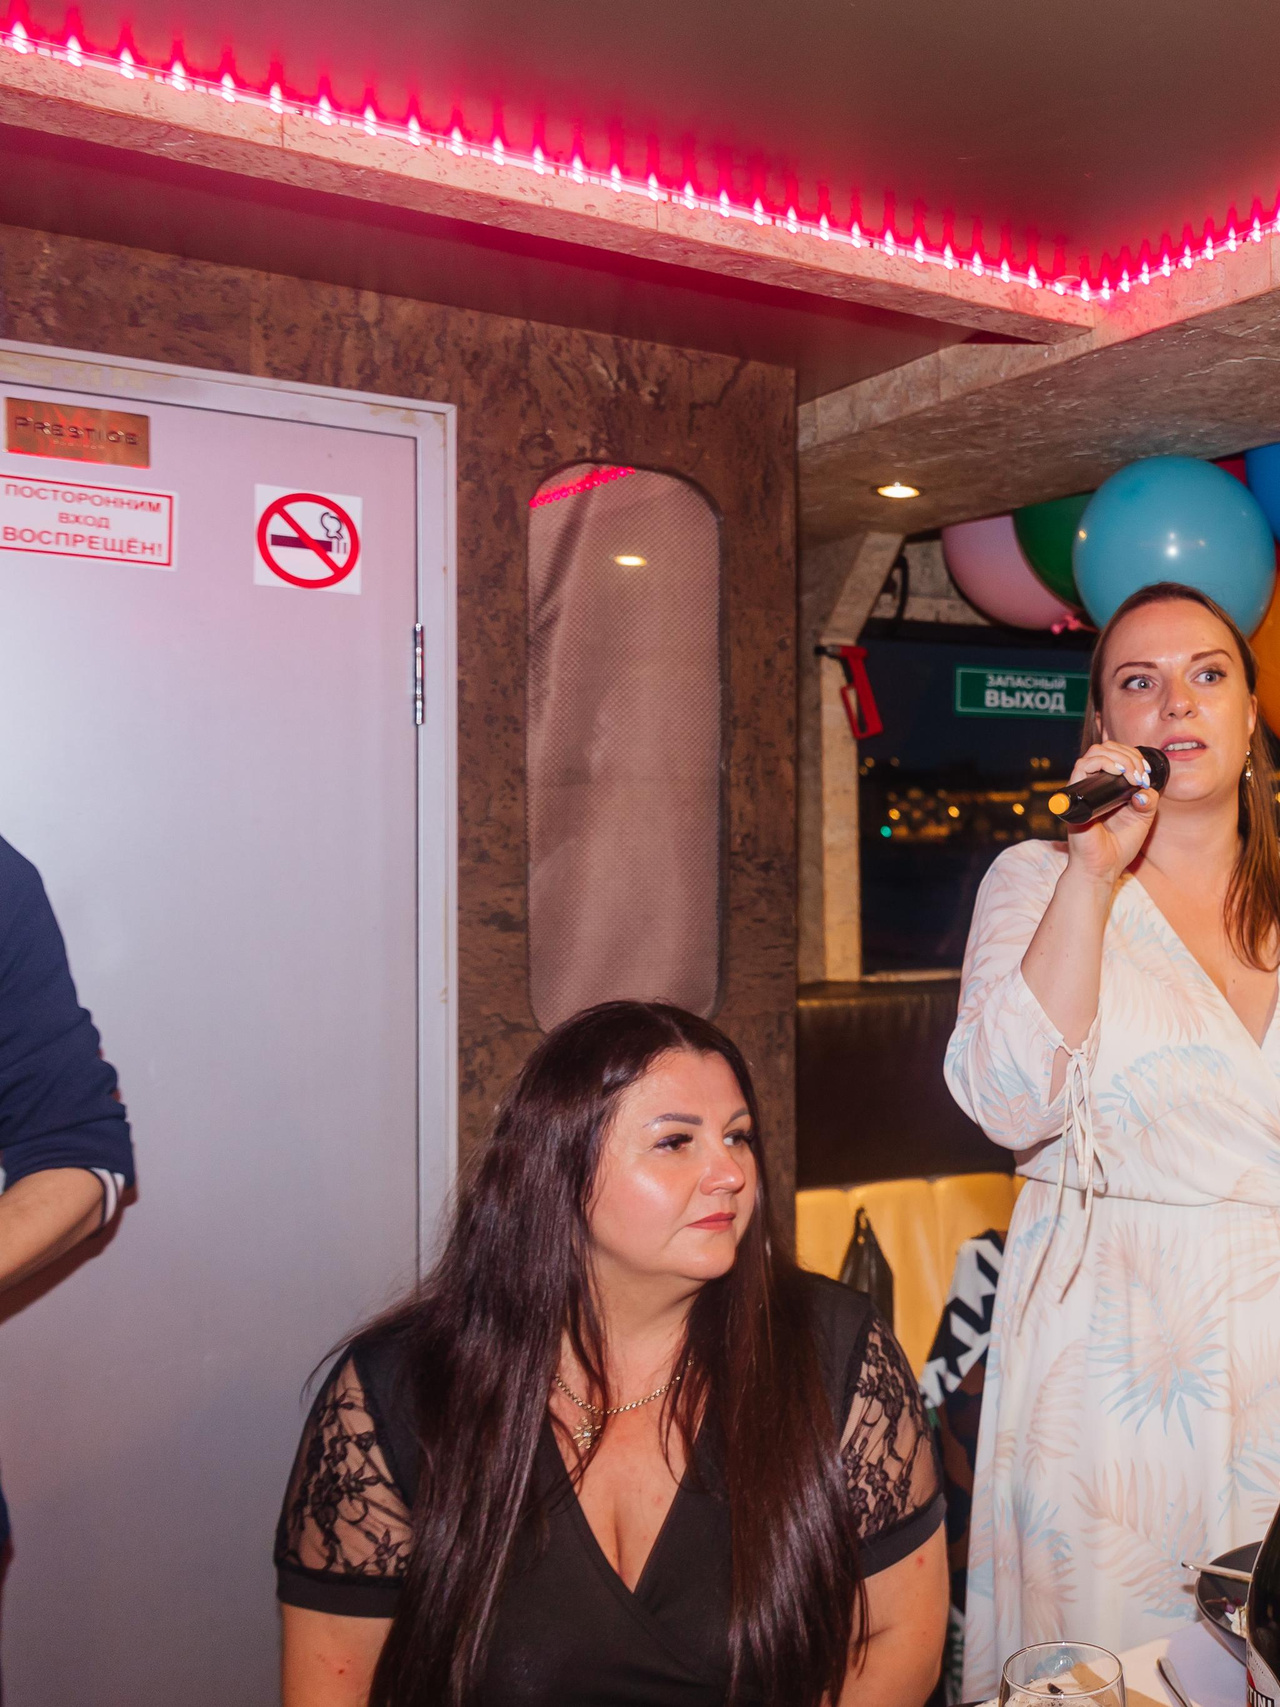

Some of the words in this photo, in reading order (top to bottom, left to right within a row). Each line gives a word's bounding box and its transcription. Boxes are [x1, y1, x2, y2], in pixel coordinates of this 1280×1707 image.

[14, 416, 139, 446] PRESTIGE
[4, 483, 161, 513] ПОСТОРОННИМ
[58, 511, 110, 529] ВХОД
[2, 526, 162, 557] ВОСПРЕЩЁН!
[986, 673, 1067, 690] ЗАПАСНЫЙ
[984, 689, 1066, 714] ВЫХОД
